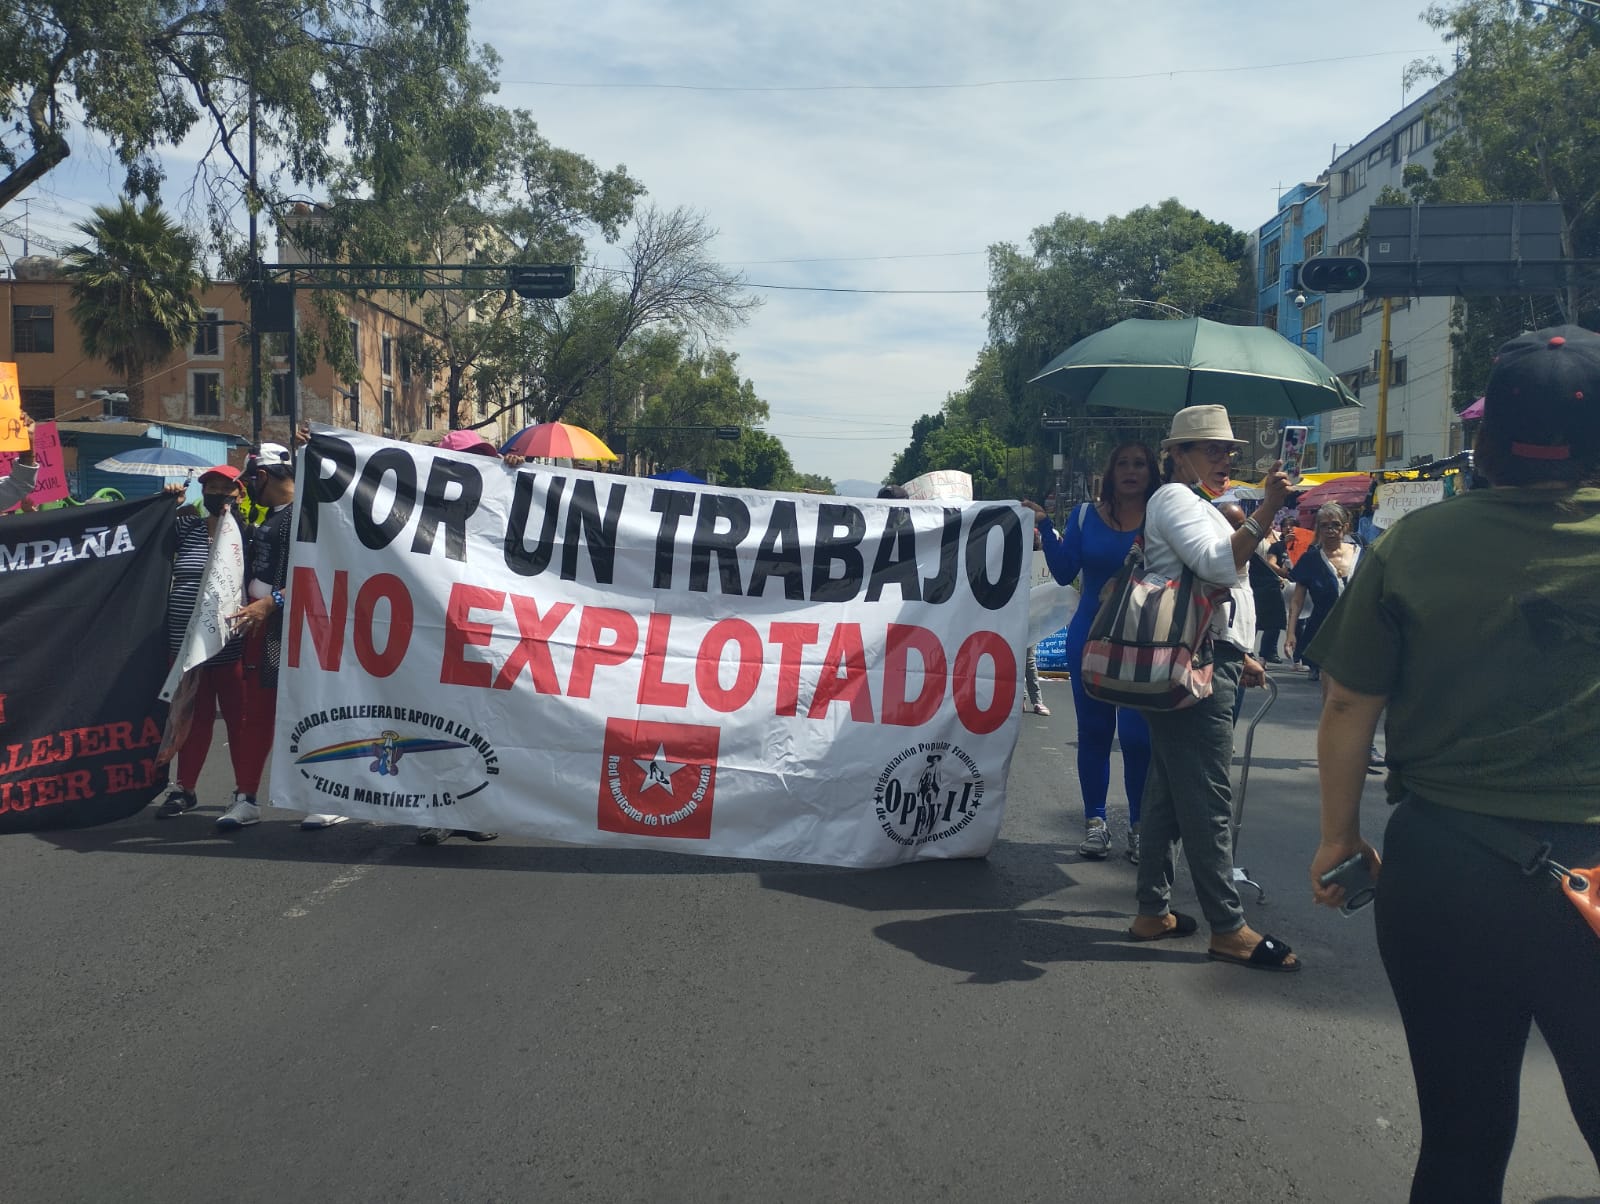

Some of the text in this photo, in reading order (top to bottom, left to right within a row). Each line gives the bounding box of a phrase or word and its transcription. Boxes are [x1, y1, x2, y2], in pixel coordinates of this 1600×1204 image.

[1384, 483, 1407, 496] SOY
[296, 432, 1024, 610] POR UN TRABAJO
[287, 565, 1017, 735] NO EXPLOTADO
[0, 717, 162, 776] LEJERA
[290, 704, 500, 775] BRIGADA CALLEJERA DE APOYO A LA MUJER
[608, 755, 711, 826] Red Mexicana de Trabajo Sexual
[874, 741, 984, 798] Organización Popular Francisco Villa
[432, 792, 456, 808] A.C.
[876, 807, 886, 821] de
